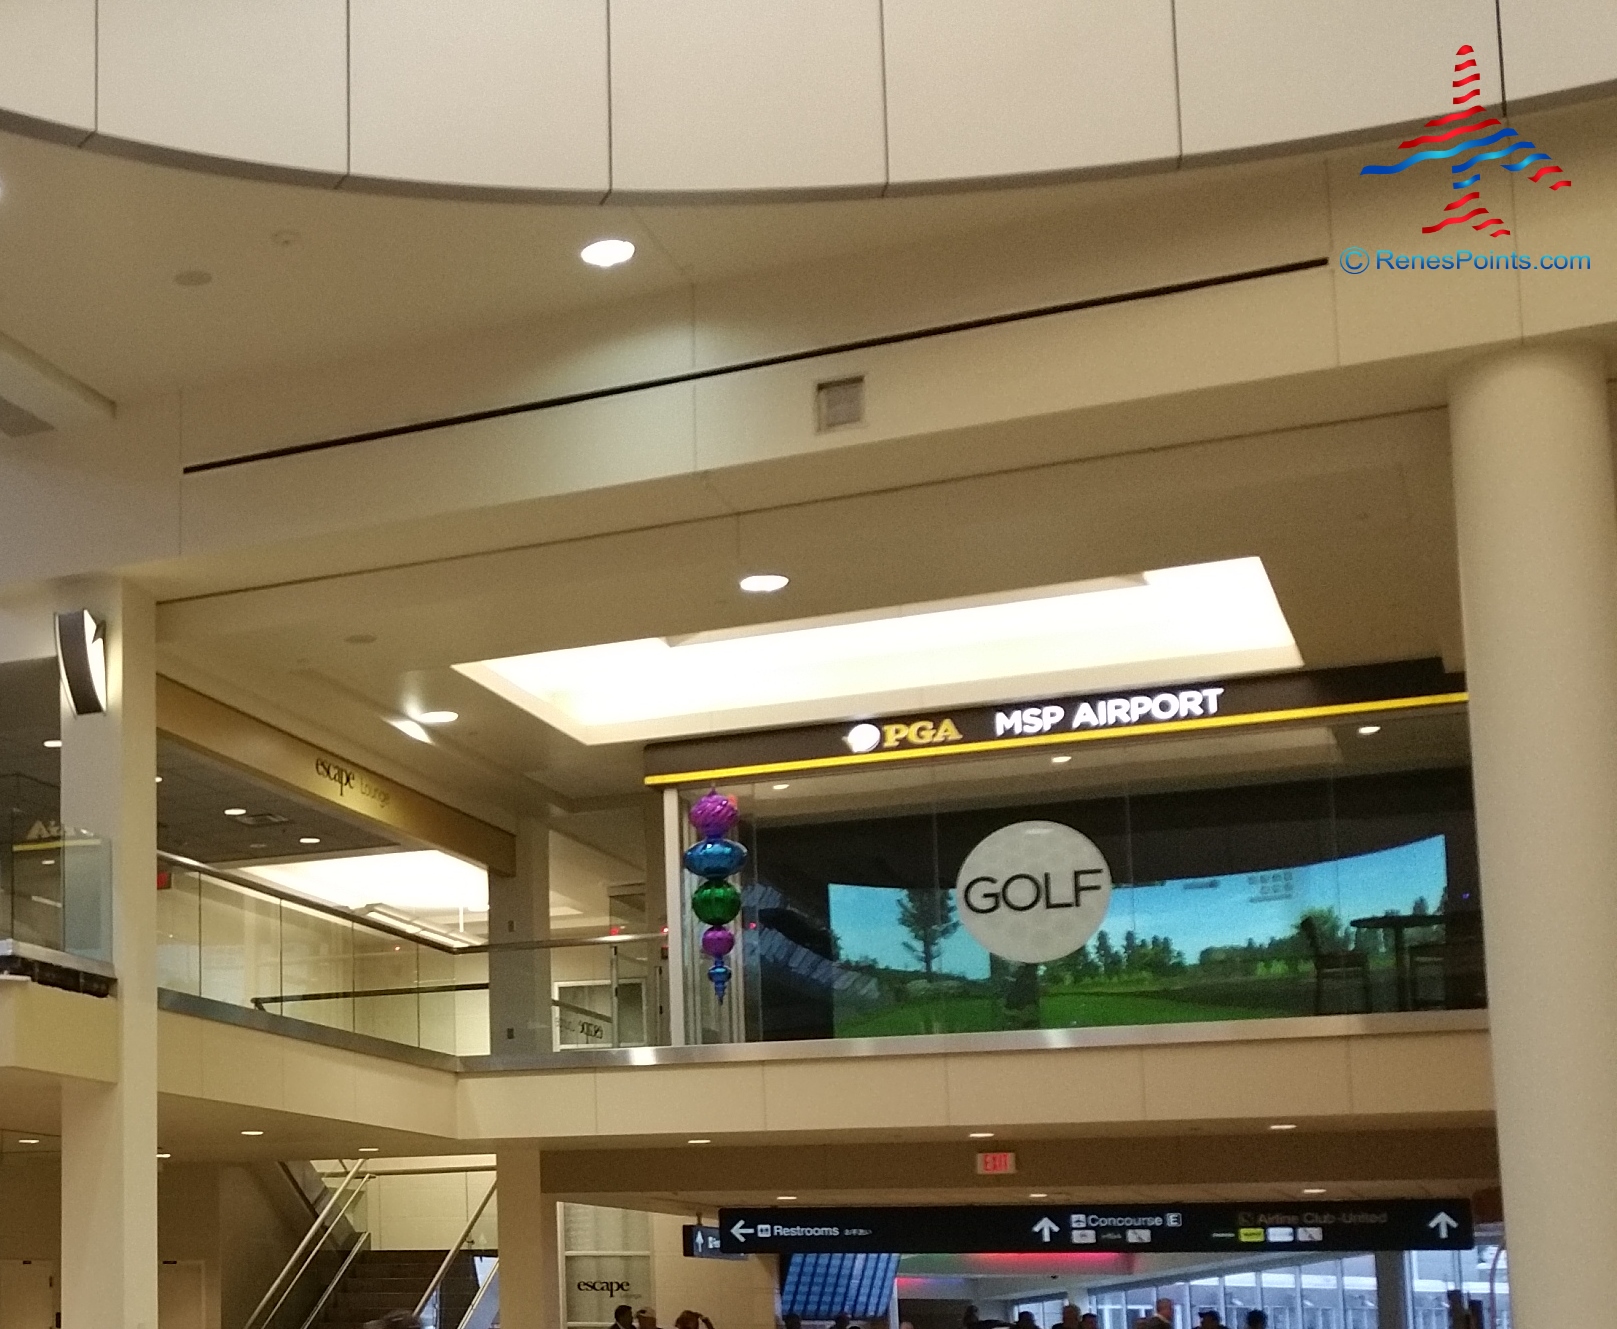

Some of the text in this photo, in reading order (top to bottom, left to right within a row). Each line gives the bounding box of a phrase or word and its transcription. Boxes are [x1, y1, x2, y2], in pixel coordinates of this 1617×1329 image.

[883, 688, 1224, 748] PGA MSP AIRPORT
[315, 758, 355, 797] escape
[963, 868, 1104, 914] GOLF
[984, 1153, 1009, 1171] EXIT
[1088, 1213, 1181, 1227] Concourse E
[1257, 1213, 1300, 1225] Airline
[773, 1225, 840, 1237] Restrooms
[577, 1281, 630, 1298] escape
